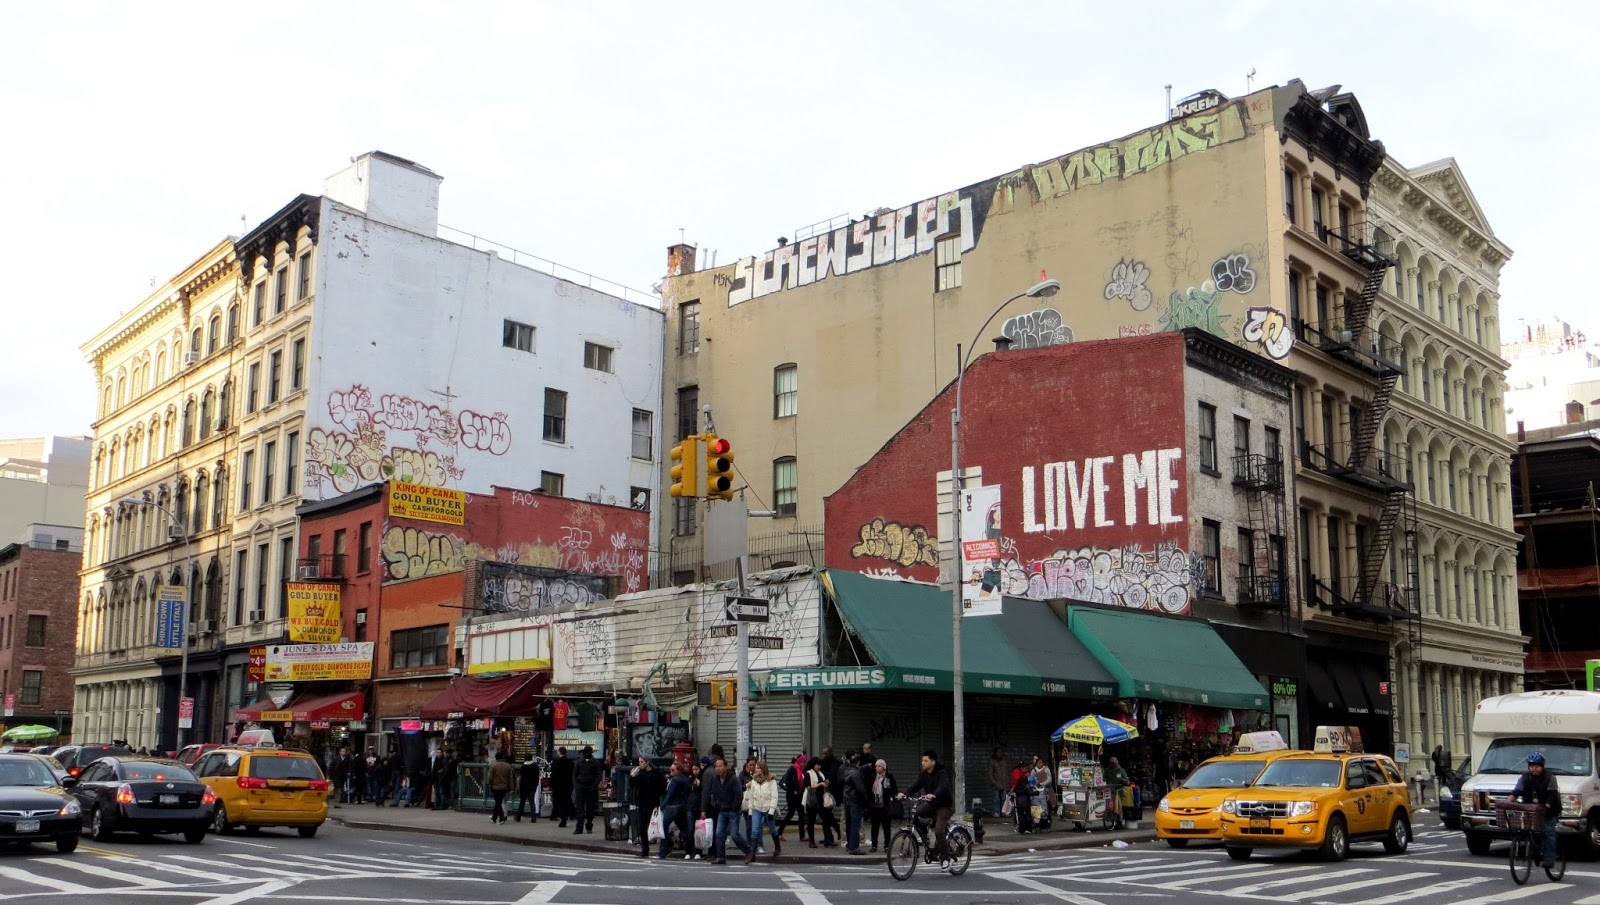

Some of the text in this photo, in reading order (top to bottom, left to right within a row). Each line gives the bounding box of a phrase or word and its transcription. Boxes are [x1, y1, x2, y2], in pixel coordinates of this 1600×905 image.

[396, 484, 458, 499] KING OF CANAL
[1022, 448, 1183, 533] LOVE ME
[392, 492, 461, 509] GOLD BUYER
[318, 584, 339, 592] CANAL
[290, 592, 338, 600] GOLD BUYER
[732, 604, 742, 613] ONE
[159, 601, 167, 646] CHINATOWN
[712, 626, 736, 637] CANAL ST
[750, 639, 781, 648] BROADWAY
[1042, 682, 1055, 692] 419
[1092, 686, 1113, 696] T-SHIRT
[1286, 684, 1296, 694] OFF
[1065, 732, 1100, 742] SABRETT
